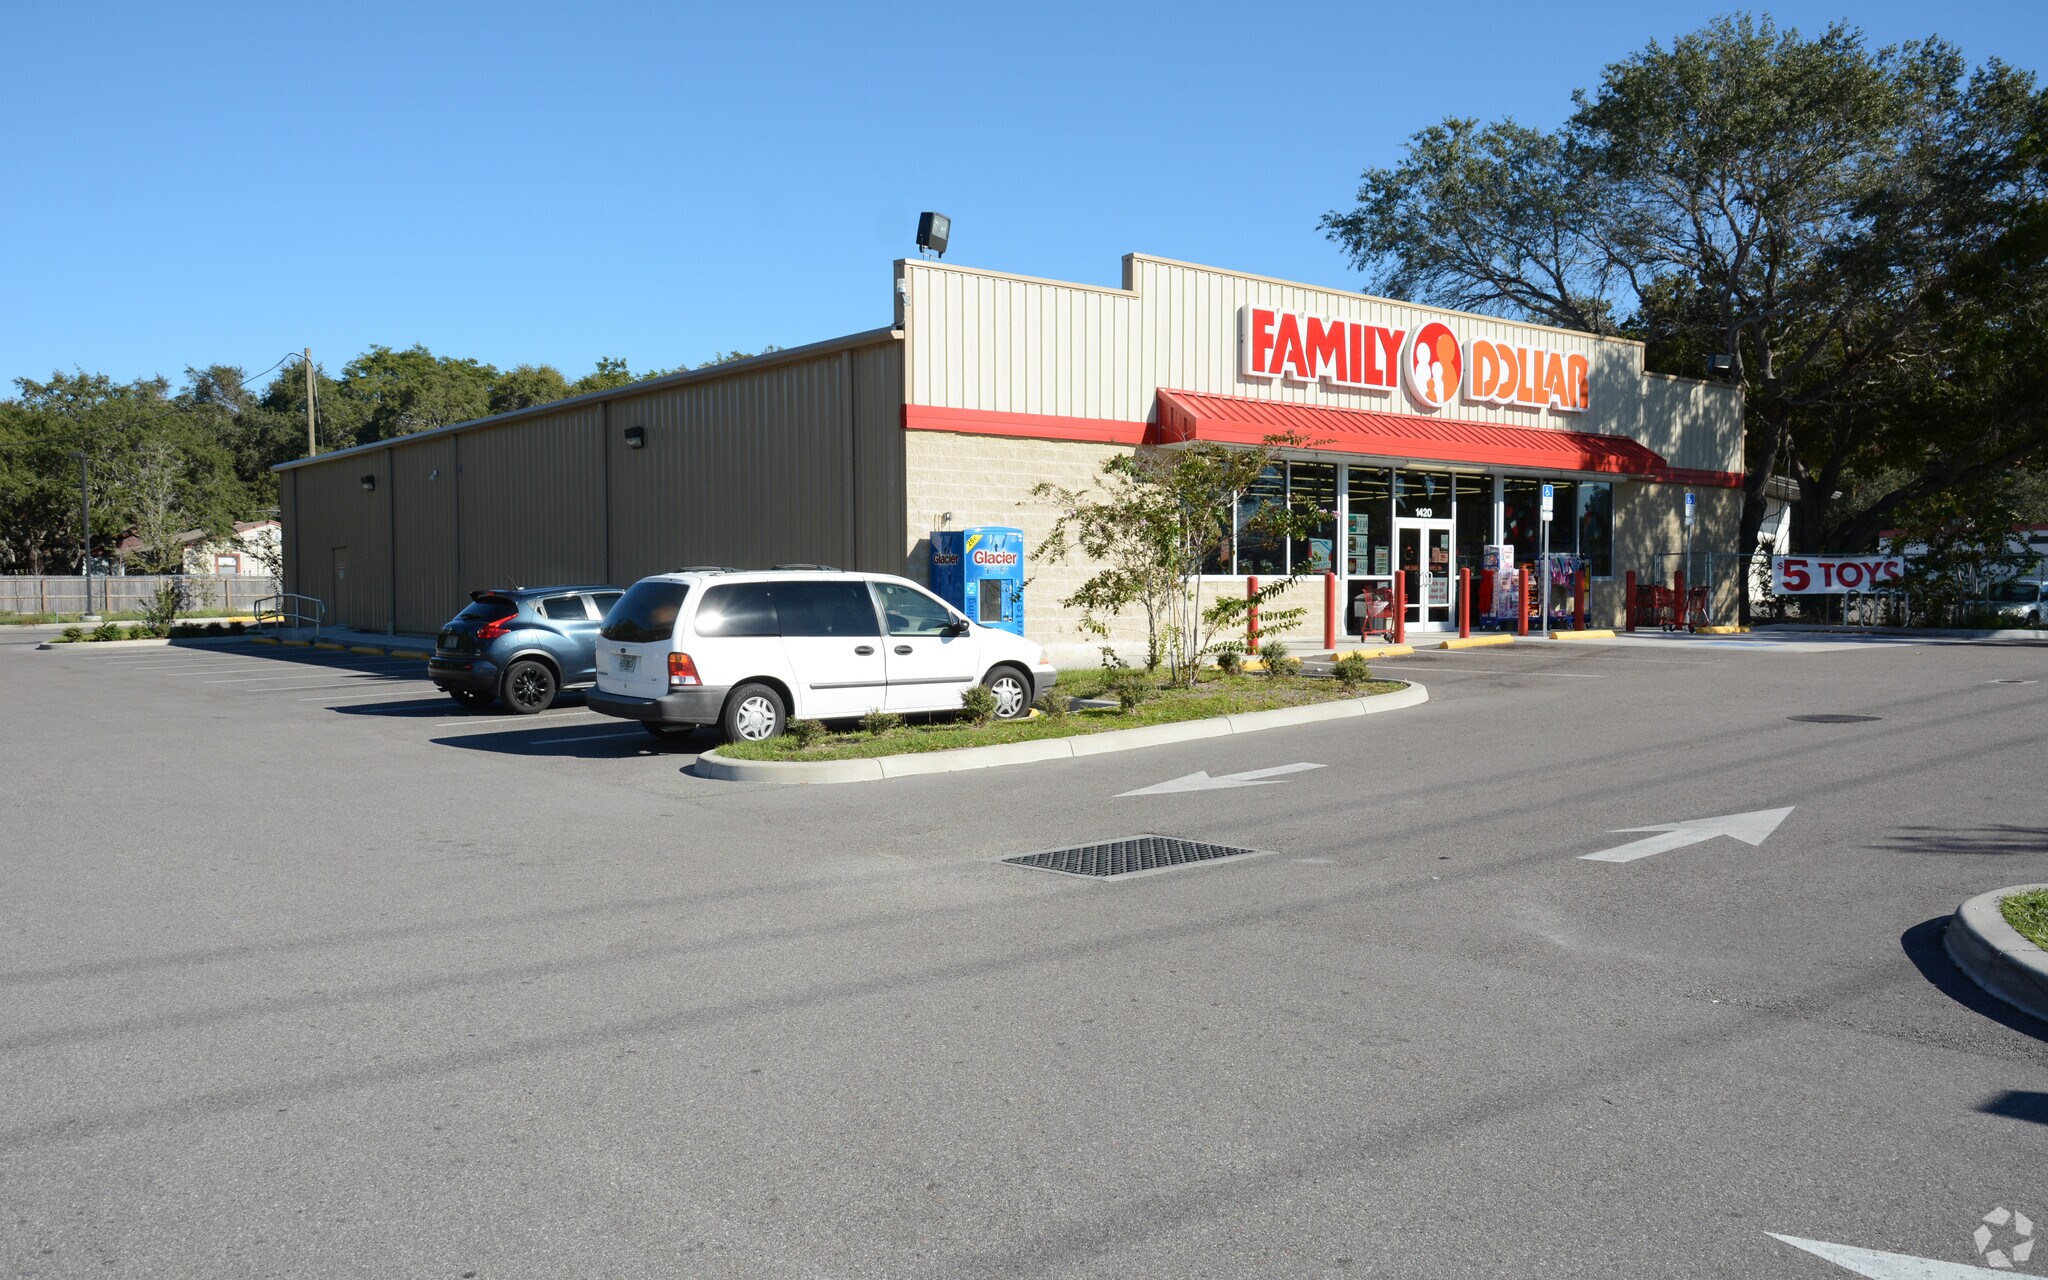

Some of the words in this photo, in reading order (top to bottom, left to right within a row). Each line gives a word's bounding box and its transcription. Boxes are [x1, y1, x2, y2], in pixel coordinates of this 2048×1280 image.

[1252, 308, 1406, 388] FAMILY
[1472, 339, 1589, 409] DOLLAR
[1415, 507, 1433, 517] 1420
[933, 553, 960, 564] Glacier
[973, 550, 1017, 564] Glacier
[1817, 561, 1900, 588] TOYS
